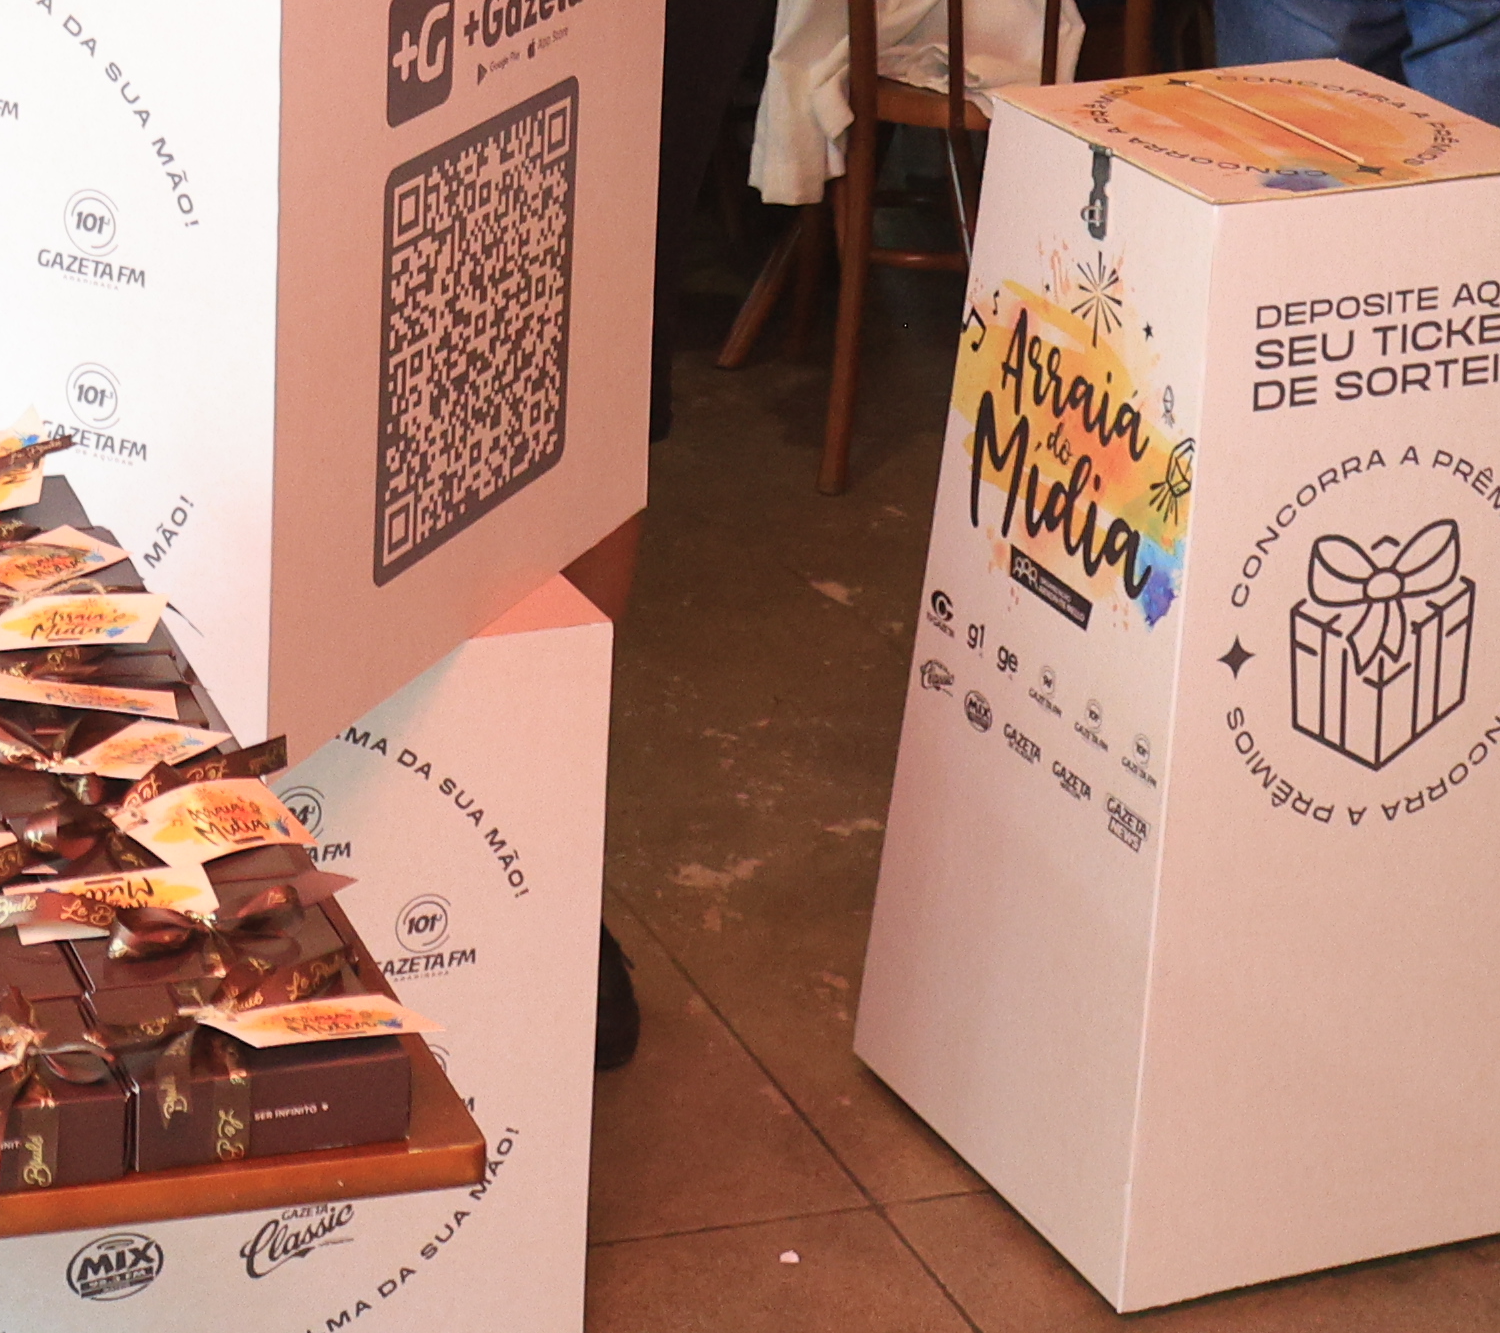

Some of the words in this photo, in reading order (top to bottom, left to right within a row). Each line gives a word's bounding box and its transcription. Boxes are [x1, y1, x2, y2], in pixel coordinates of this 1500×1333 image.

[392, 1, 451, 84] +G
[1216, 74, 1407, 109] CONCORRA
[62, 14, 98, 57] DA
[104, 61, 151, 129] SUA
[151, 136, 200, 228] MÃO!
[36, 248, 115, 282] GAZETA
[116, 265, 147, 289] FM
[1255, 286, 1440, 330] DEPOSITE
[1254, 329, 1355, 371] SEU
[1001, 307, 1150, 463] Arraiá
[1252, 375, 1318, 413] DE
[118, 438, 148, 462] FM
[1046, 422, 1074, 466] do
[970, 389, 1153, 601] Mídia
[142, 494, 195, 570] MÃO!
[1231, 448, 1387, 609] CONCORRA
[1399, 445, 1421, 466] A
[996, 645, 1020, 674] ge
[1003, 722, 1042, 763] GAZETA
[1052, 759, 1092, 801] GAZETA
[1226, 706, 1334, 825] PRÊMIOS
[396, 748, 434, 780] DA
[438, 777, 486, 829] SUA
[484, 827, 530, 899] MÃO!
[1106, 796, 1148, 838] GAZETA
[1346, 806, 1367, 827] A
[321, 841, 352, 862] FM
[447, 948, 477, 968] FM
[281, 1203, 329, 1221] GAZETA
[76, 1240, 156, 1283] MIX
[239, 1204, 355, 1279] Classic
[377, 1266, 417, 1299] DA
[420, 1208, 472, 1261] SUA
